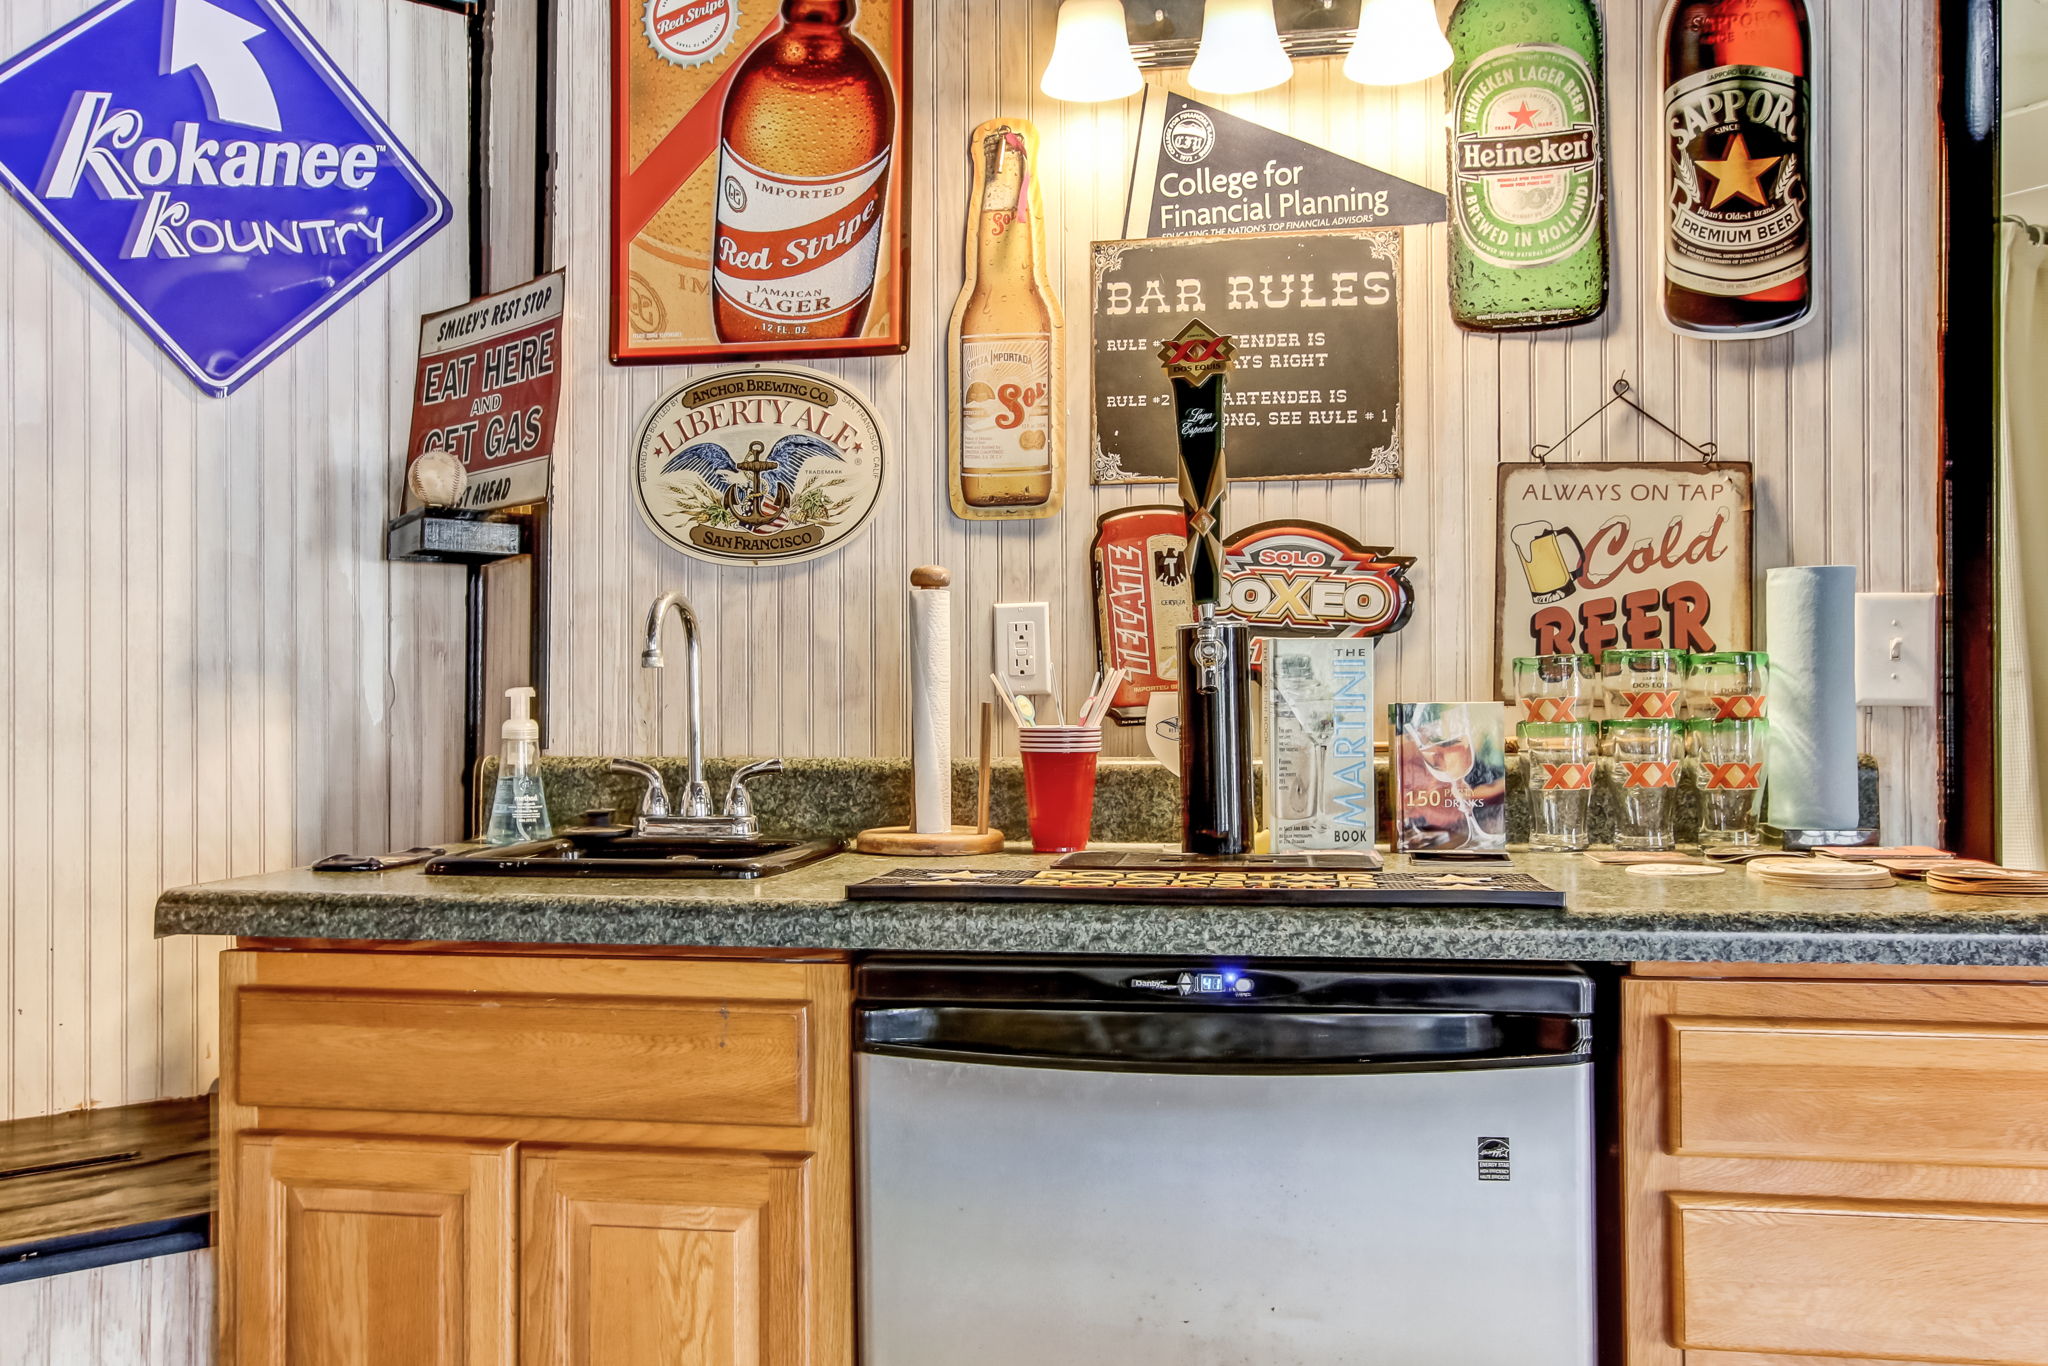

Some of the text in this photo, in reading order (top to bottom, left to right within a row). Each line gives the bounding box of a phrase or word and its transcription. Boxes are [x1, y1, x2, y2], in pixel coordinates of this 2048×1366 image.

[657, 0, 725, 35] Red Stripe
[1465, 68, 1514, 123] HEINEKEN
[1520, 65, 1566, 87] LAGER
[1563, 78, 1586, 115] BEER
[45, 91, 377, 200] Kokanee
[1464, 135, 1589, 168] Heineken
[755, 180, 846, 199] IMPORTED
[1159, 159, 1303, 199] College for
[1160, 186, 1389, 230] Financial Planning
[1466, 194, 1509, 246] BREWED
[1515, 231, 1532, 248] IN
[1538, 185, 1588, 245] HOLLAND
[1697, 204, 1776, 220] Japan's Oldest Brand
[720, 199, 876, 271] Red Stripe
[1210, 228, 1226, 236] THE
[1228, 224, 1267, 234] NATION'S
[1268, 222, 1285, 231] TOP
[1286, 218, 1330, 229] FINANCIAL
[1332, 214, 1374, 225] ADVISORS
[1681, 218, 1751, 243] PREMIUM
[1757, 213, 1796, 240] BEER
[745, 290, 833, 314] LAGER
[754, 284, 824, 298] JAMAICAN
[1106, 271, 1391, 315] BAR RULES
[437, 285, 552, 342] SMILEY'S REST STOP
[761, 322, 773, 334] 12
[777, 323, 791, 335] FL.
[1106, 338, 1148, 352] RULE
[1232, 333, 1300, 348] ENDER
[1307, 332, 1326, 347] IS
[1167, 336, 1227, 364] XX
[423, 328, 555, 406] EAT HERE
[990, 349, 1034, 373] IMPORTADA
[1173, 363, 1221, 373] DOS EQUIS
[1269, 353, 1328, 368] RIGHT
[693, 379, 829, 404] ANCHOR BREWING CO.
[842, 395, 857, 410] SAN
[1106, 389, 1347, 407] RULE #2 ARTENDER IS
[470, 394, 502, 416] AND
[1187, 408, 1214, 424] Lager
[1268, 411, 1302, 425] SEE
[1308, 409, 1358, 424] RULE
[1380, 408, 1389, 423] 1
[423, 405, 544, 466] GET GAS
[640, 397, 680, 482] BREWED AND BOTTLED BY
[657, 399, 859, 458] LIBERTY ALE
[1181, 421, 1219, 438] Especial
[472, 477, 511, 505] AHEAD
[1522, 483, 1725, 501] ALWAYS ON TAP
[703, 532, 812, 551] SAN FRANCISCO
[1576, 506, 1730, 590] Cold
[1258, 550, 1325, 567] SOLO
[1108, 543, 1151, 684] TECATE
[1336, 648, 1366, 657] THE
[1134, 684, 1169, 693] IMPORTED
[1521, 697, 1578, 722] XX
[1621, 691, 1681, 719] XX
[1711, 695, 1767, 721] XX
[1333, 659, 1368, 827] MARTINI
[1542, 762, 1596, 790] XX
[1621, 760, 1681, 788] XX
[1701, 761, 1765, 790] XX
[1406, 790, 1441, 807] 150
[1334, 830, 1367, 843] BOOK
[1135, 979, 1160, 988] Danby
